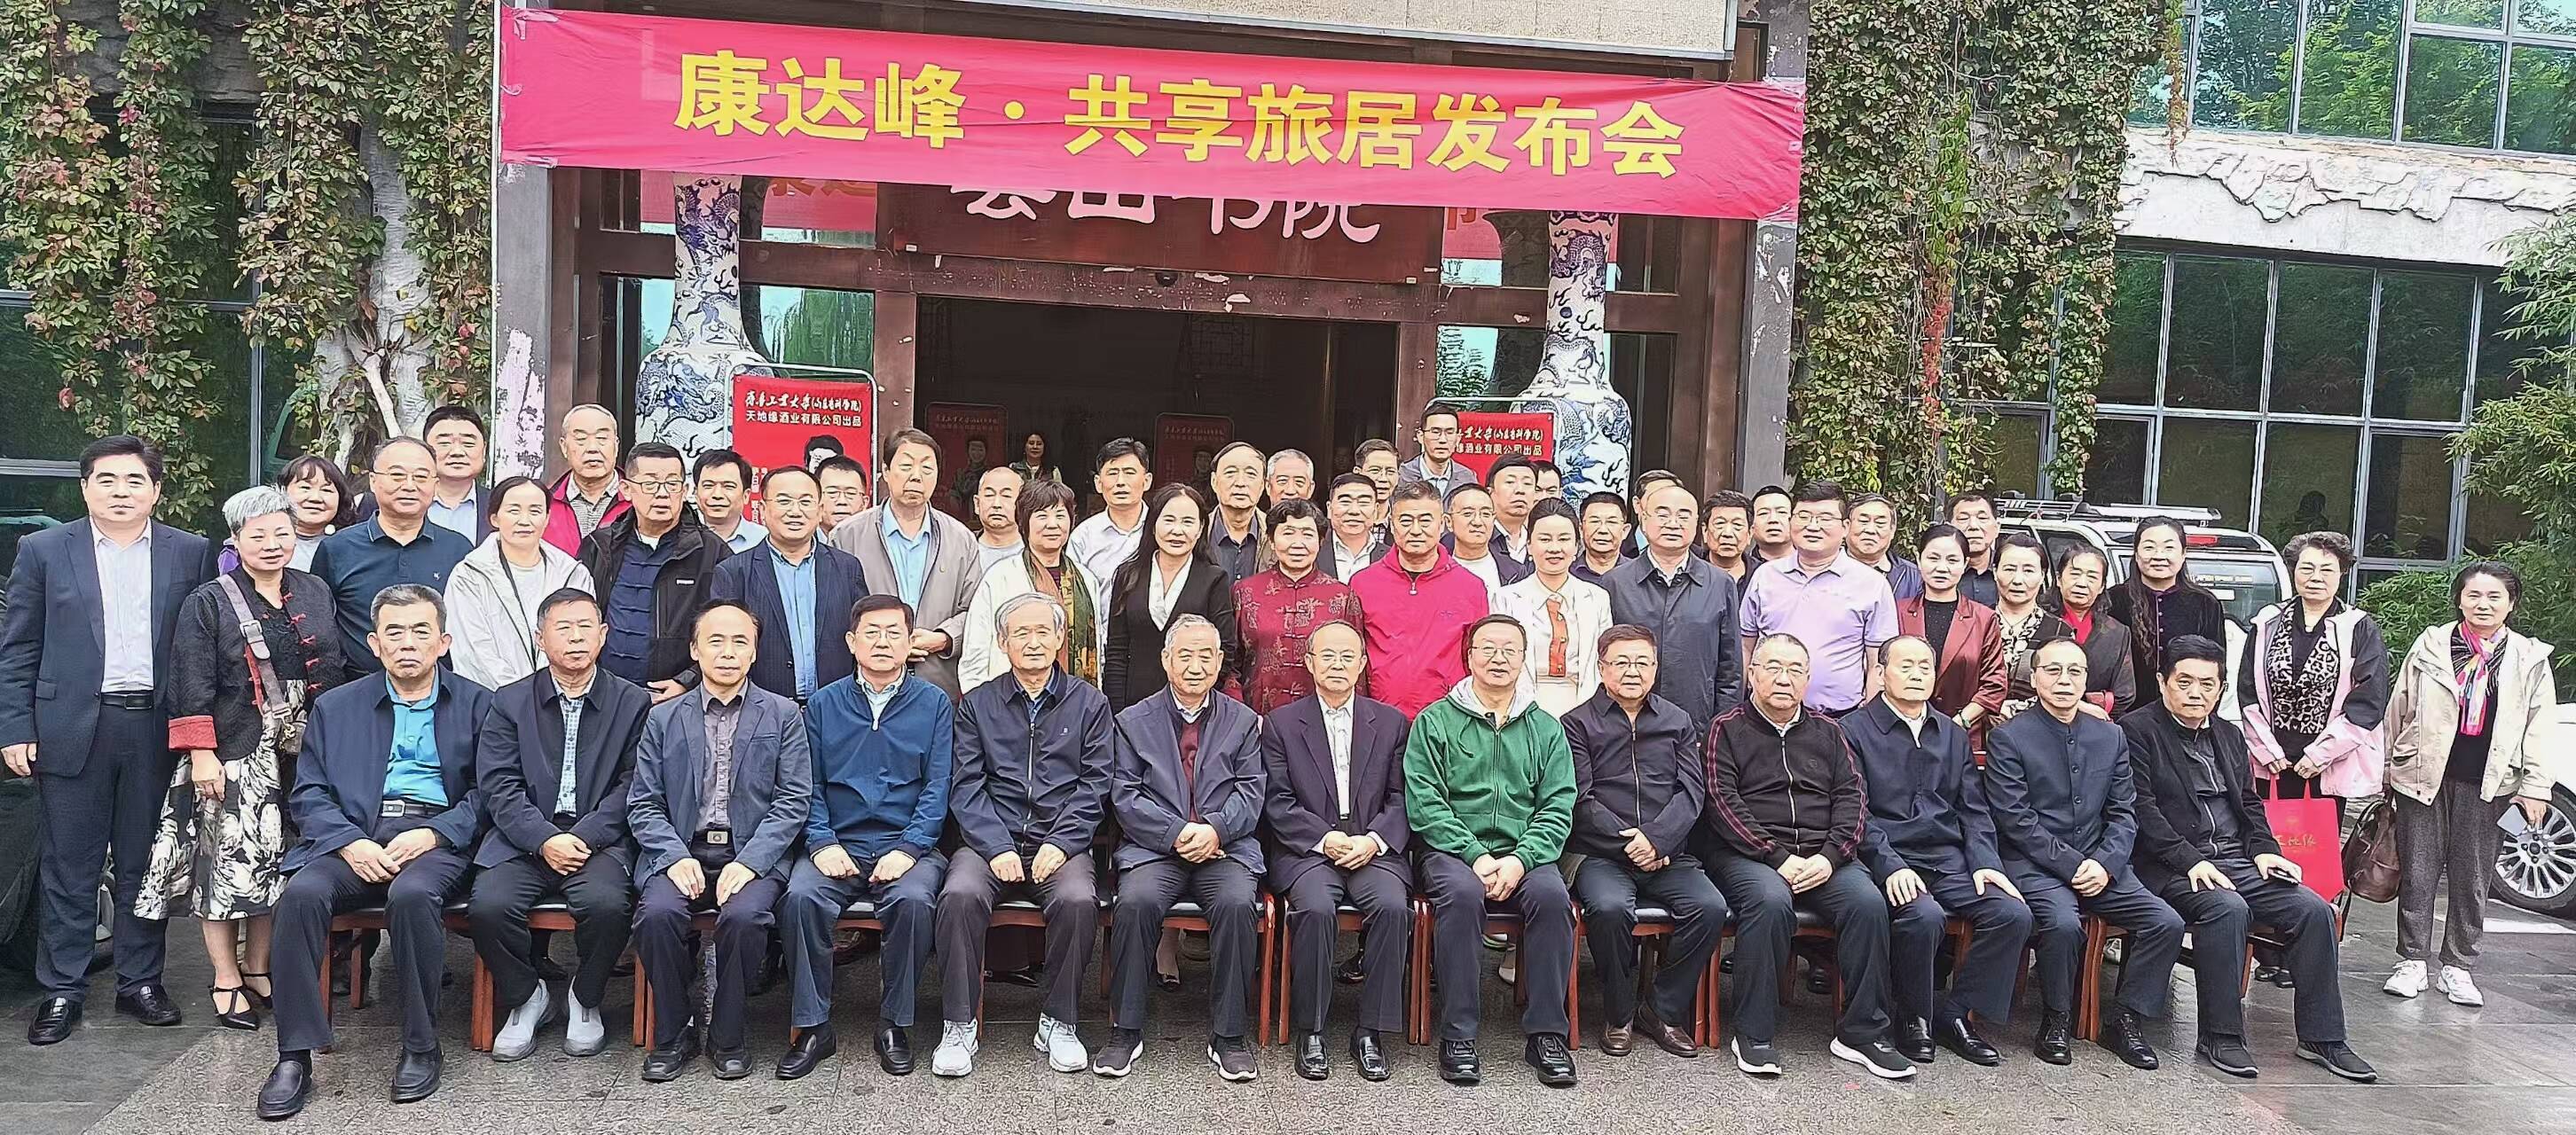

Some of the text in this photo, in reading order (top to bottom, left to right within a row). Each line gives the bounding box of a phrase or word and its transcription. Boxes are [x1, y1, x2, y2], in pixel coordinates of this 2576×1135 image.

[746, 410, 862, 427] 天地缘酒业有限公司出品
